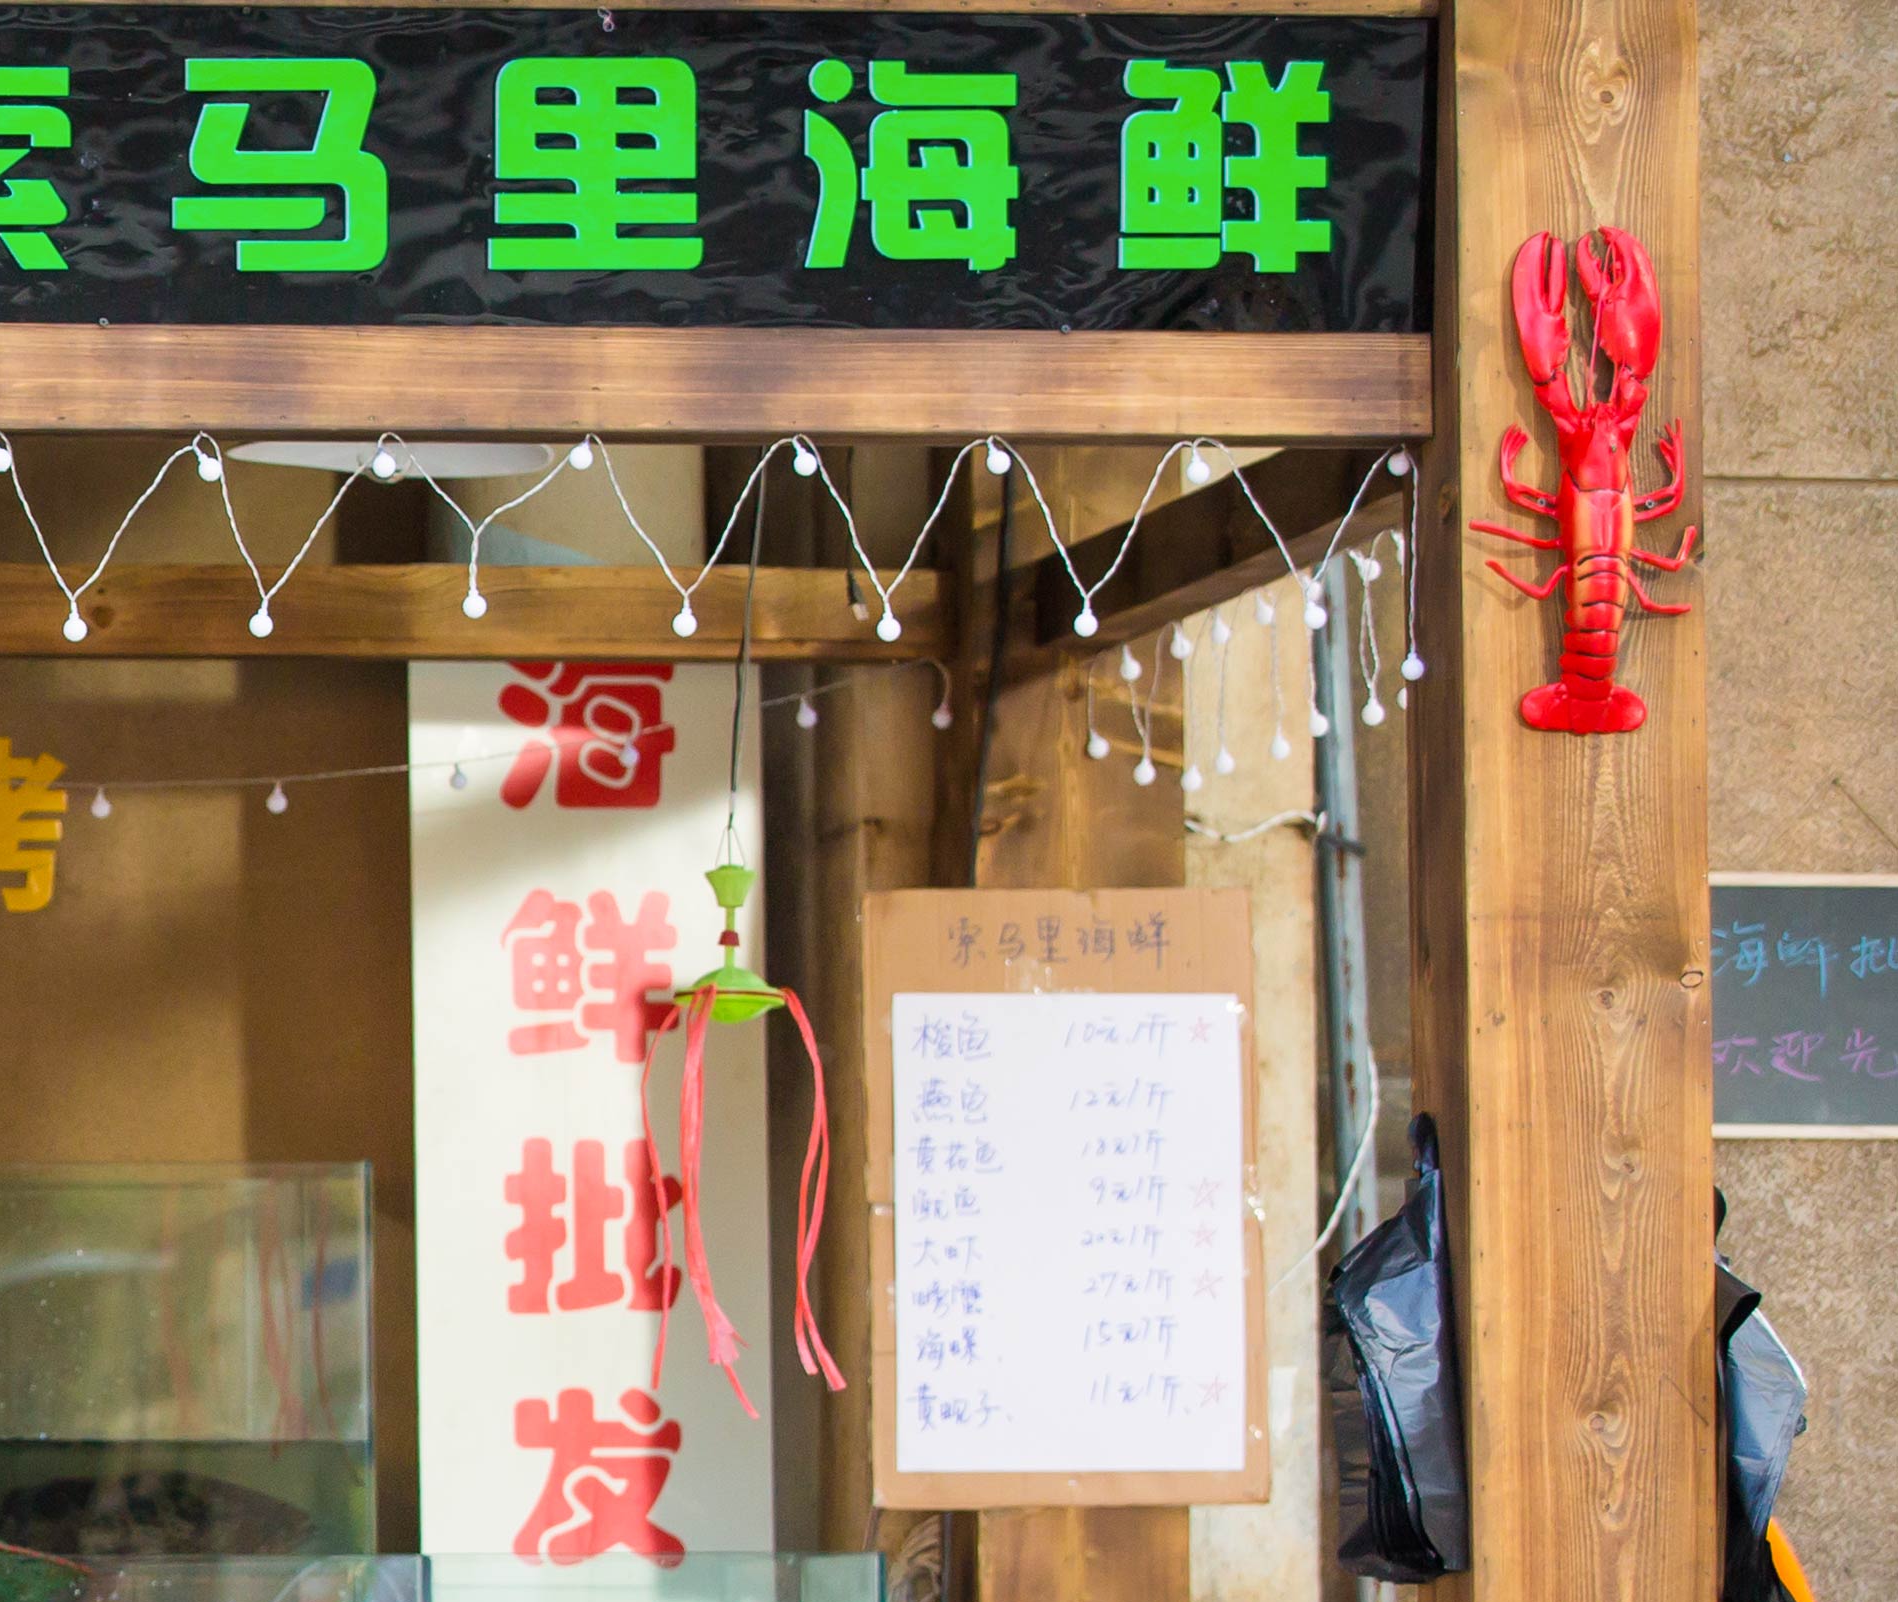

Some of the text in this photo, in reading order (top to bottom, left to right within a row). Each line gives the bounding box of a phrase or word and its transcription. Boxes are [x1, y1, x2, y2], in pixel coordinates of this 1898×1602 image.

[499, 662, 686, 1570] 海鲜批发
[949, 912, 1170, 970] 索马里海鲜
